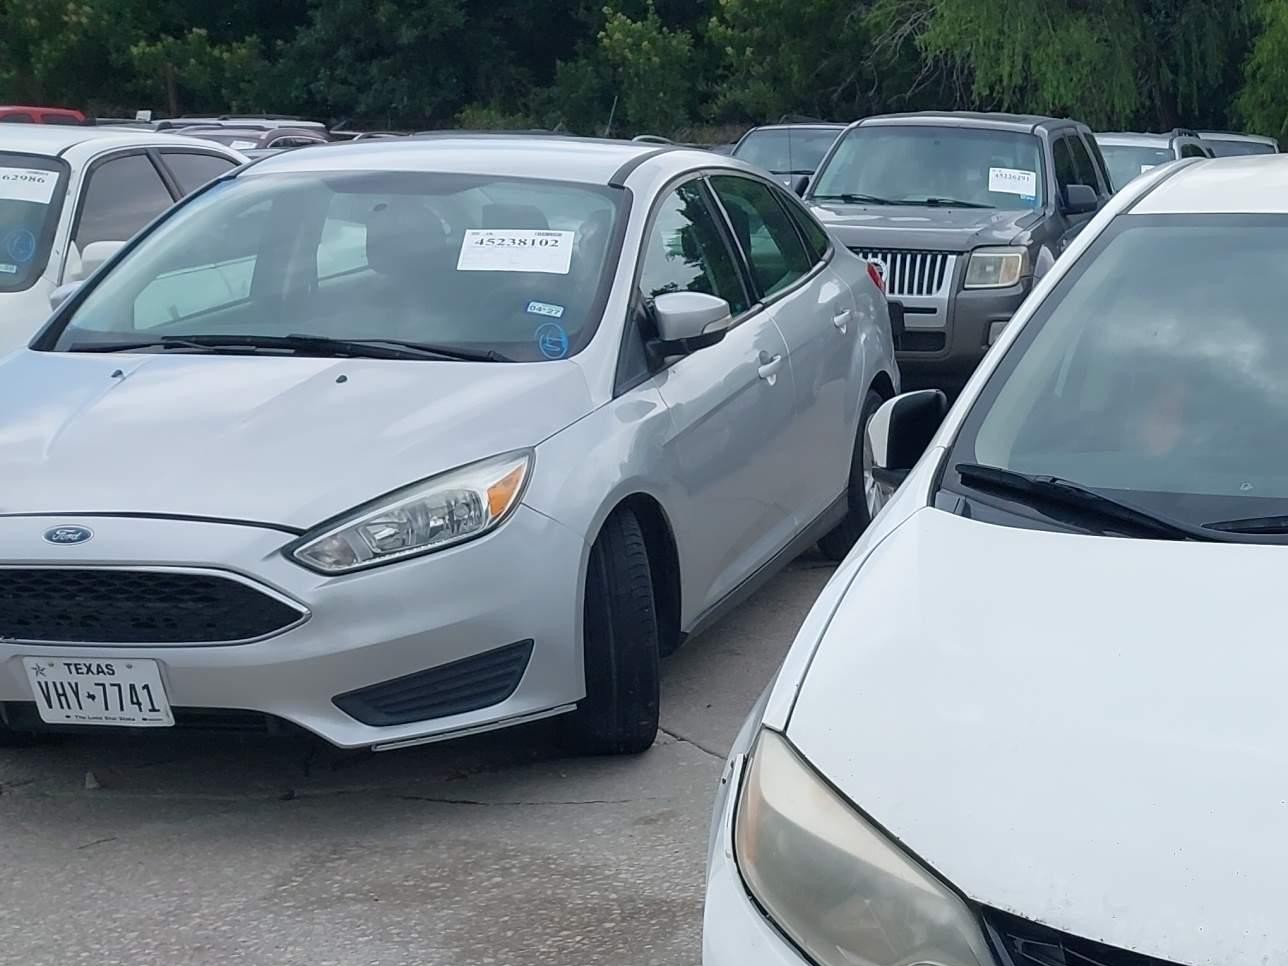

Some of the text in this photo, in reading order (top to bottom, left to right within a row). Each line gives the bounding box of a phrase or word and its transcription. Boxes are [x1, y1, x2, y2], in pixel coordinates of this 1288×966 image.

[474, 238, 560, 247] 45238102
[52, 529, 83, 541] Ford
[63, 662, 115, 676] TEXAS
